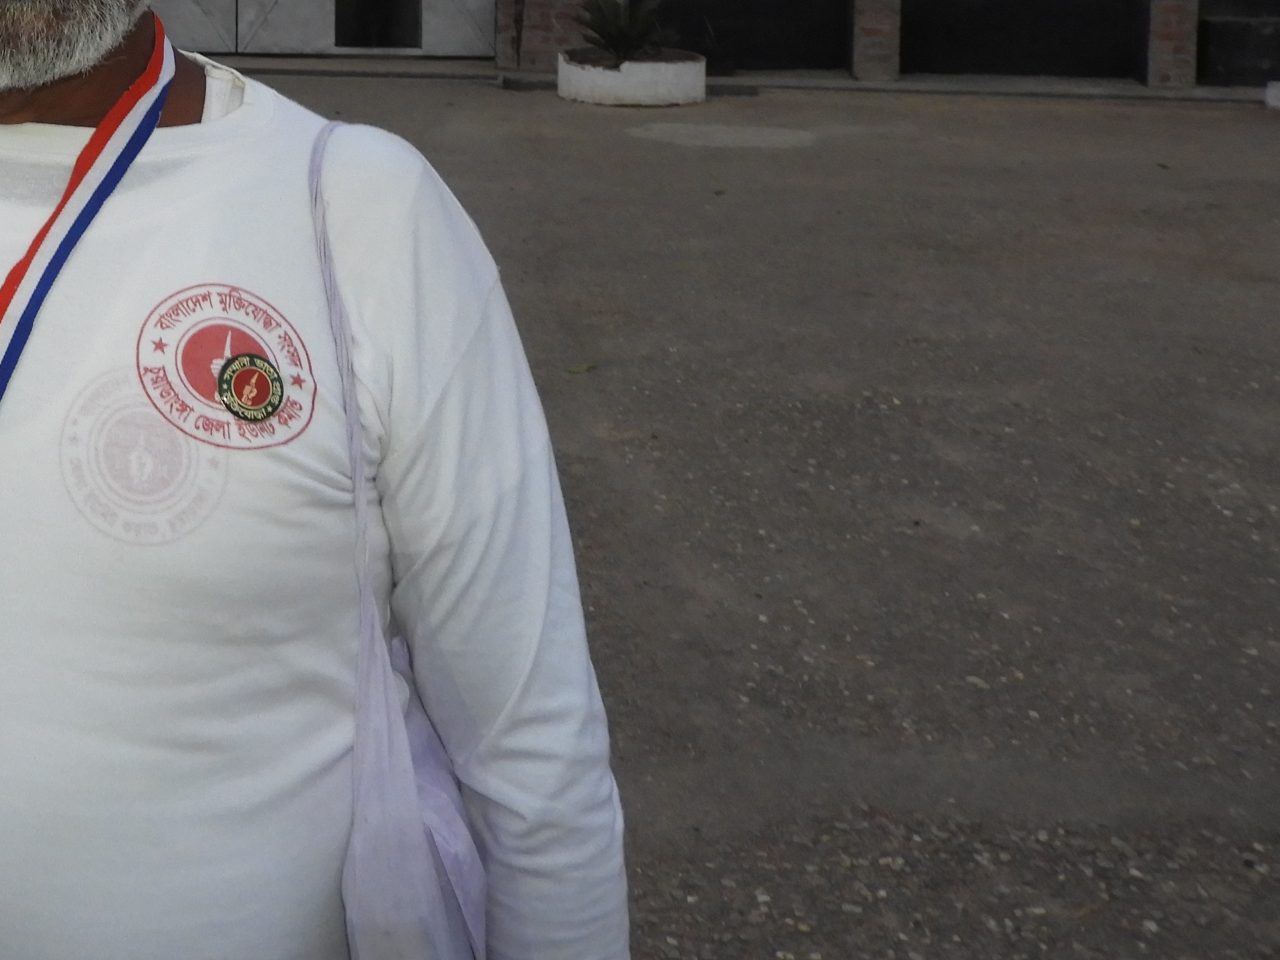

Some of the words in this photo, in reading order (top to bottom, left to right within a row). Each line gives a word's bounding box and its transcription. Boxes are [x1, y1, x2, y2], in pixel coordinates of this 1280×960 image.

[154, 290, 214, 331] বাংলাদেশ
[216, 286, 282, 333] মুক্তিযোদ্ধা
[194, 414, 231, 440] জেলা
